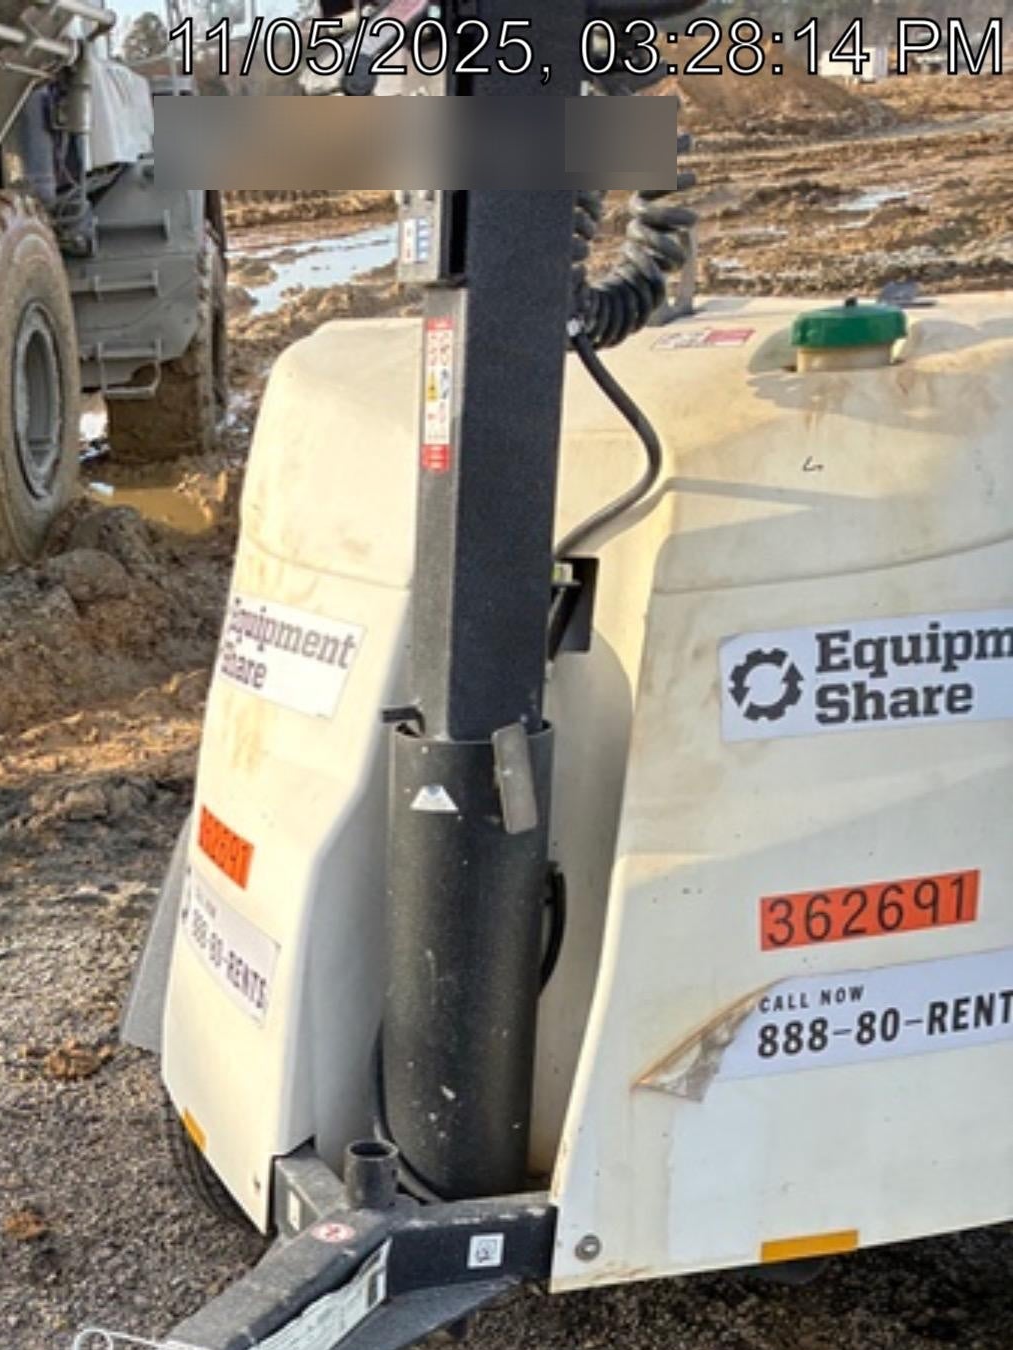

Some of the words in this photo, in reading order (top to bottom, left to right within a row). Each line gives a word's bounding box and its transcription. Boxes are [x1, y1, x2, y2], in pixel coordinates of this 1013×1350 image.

[815, 681, 974, 726] Share
[767, 875, 965, 947] 362691
[758, 992, 810, 1013] CALL
[820, 984, 864, 1006] NOW
